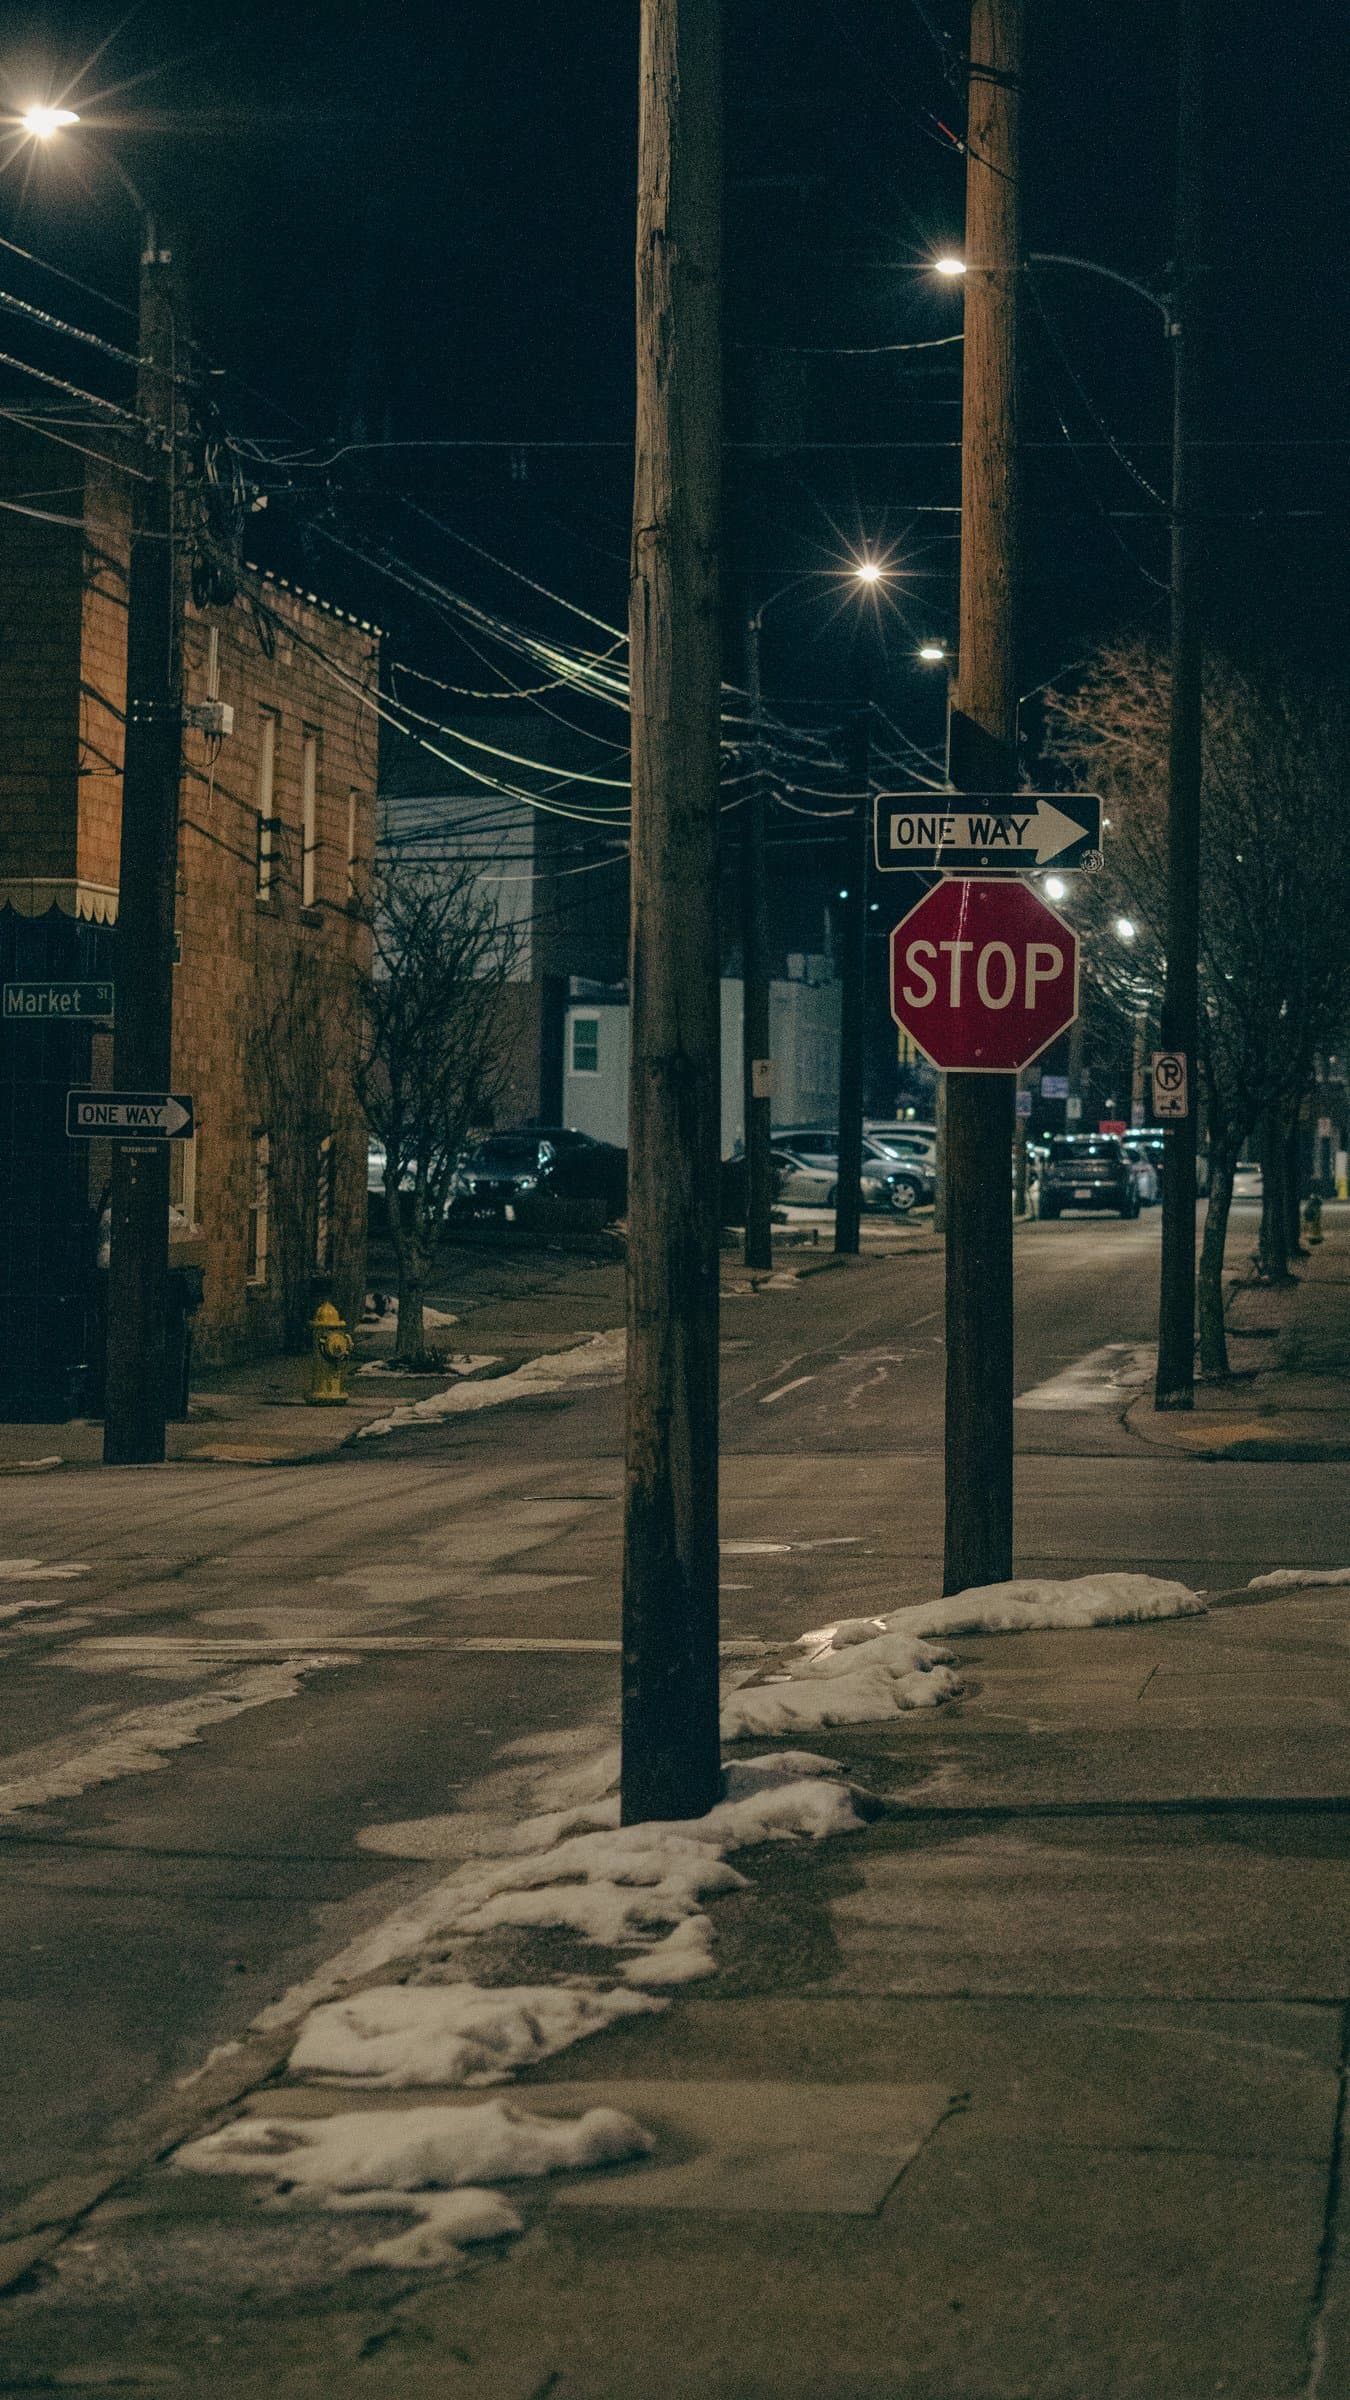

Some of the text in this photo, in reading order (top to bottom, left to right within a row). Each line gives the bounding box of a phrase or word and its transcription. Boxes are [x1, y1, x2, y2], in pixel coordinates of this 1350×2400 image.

[897, 817, 1031, 846] ONE WAY
[903, 940, 1064, 1010] STOP
[8, 988, 81, 1013] Market
[82, 1106, 163, 1125] ONE WAY
